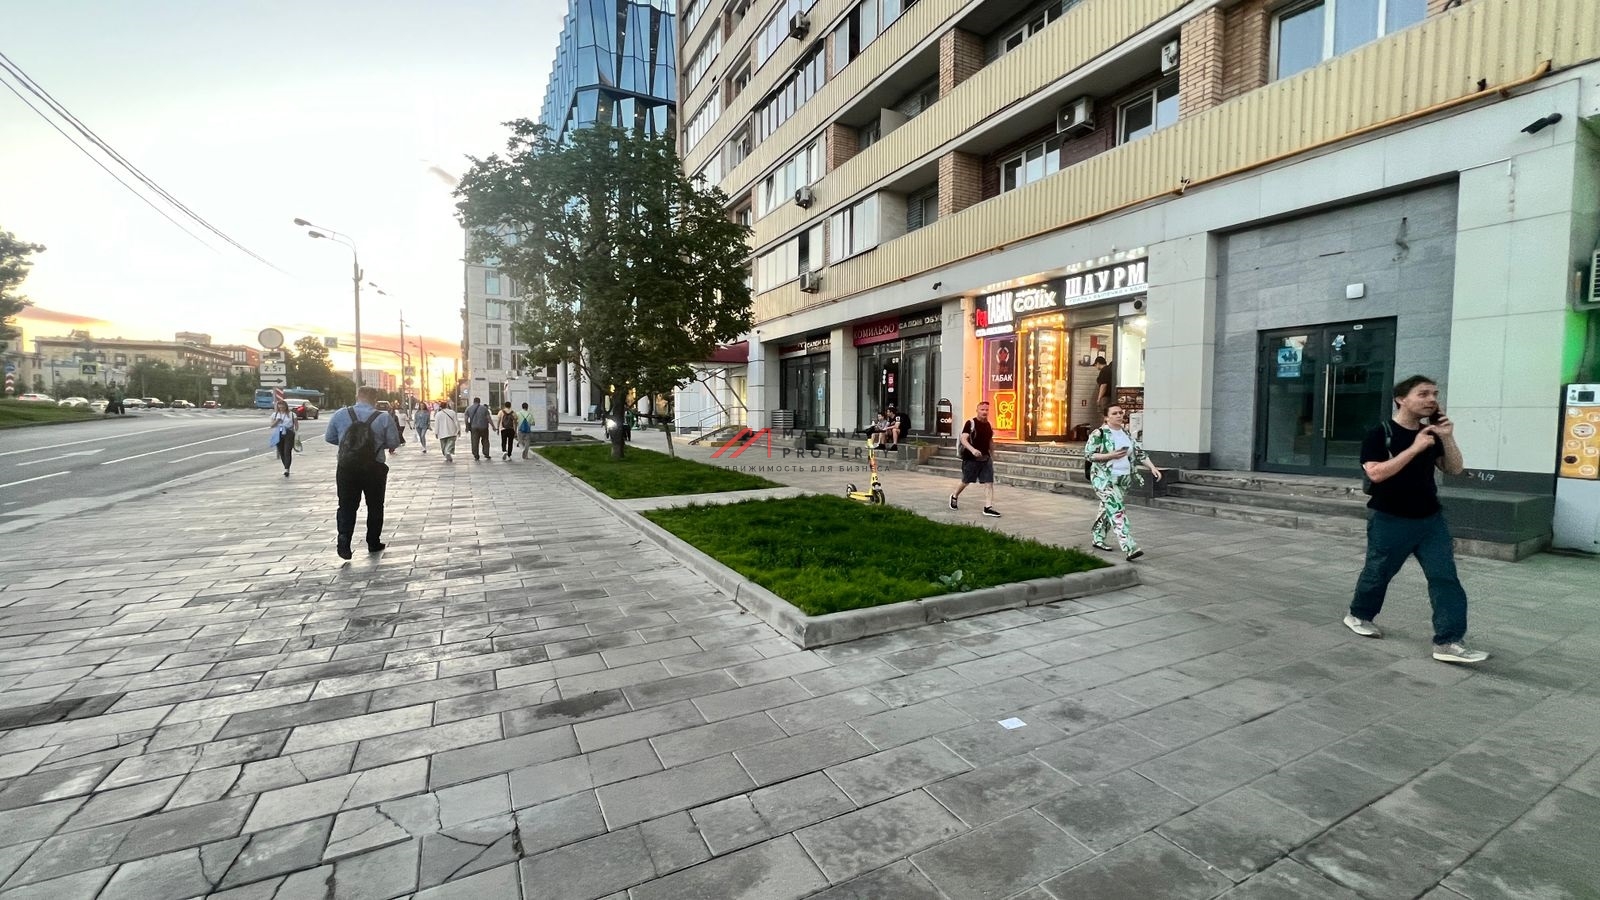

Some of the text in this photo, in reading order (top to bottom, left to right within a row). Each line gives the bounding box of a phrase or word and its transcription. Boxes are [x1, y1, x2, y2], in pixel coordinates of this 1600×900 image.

[1065, 262, 1145, 298] ШАУРМ
[986, 292, 1013, 325] ТАБАК
[1013, 290, 1057, 312] cofix
[991, 374, 1013, 382] ТАБАК
